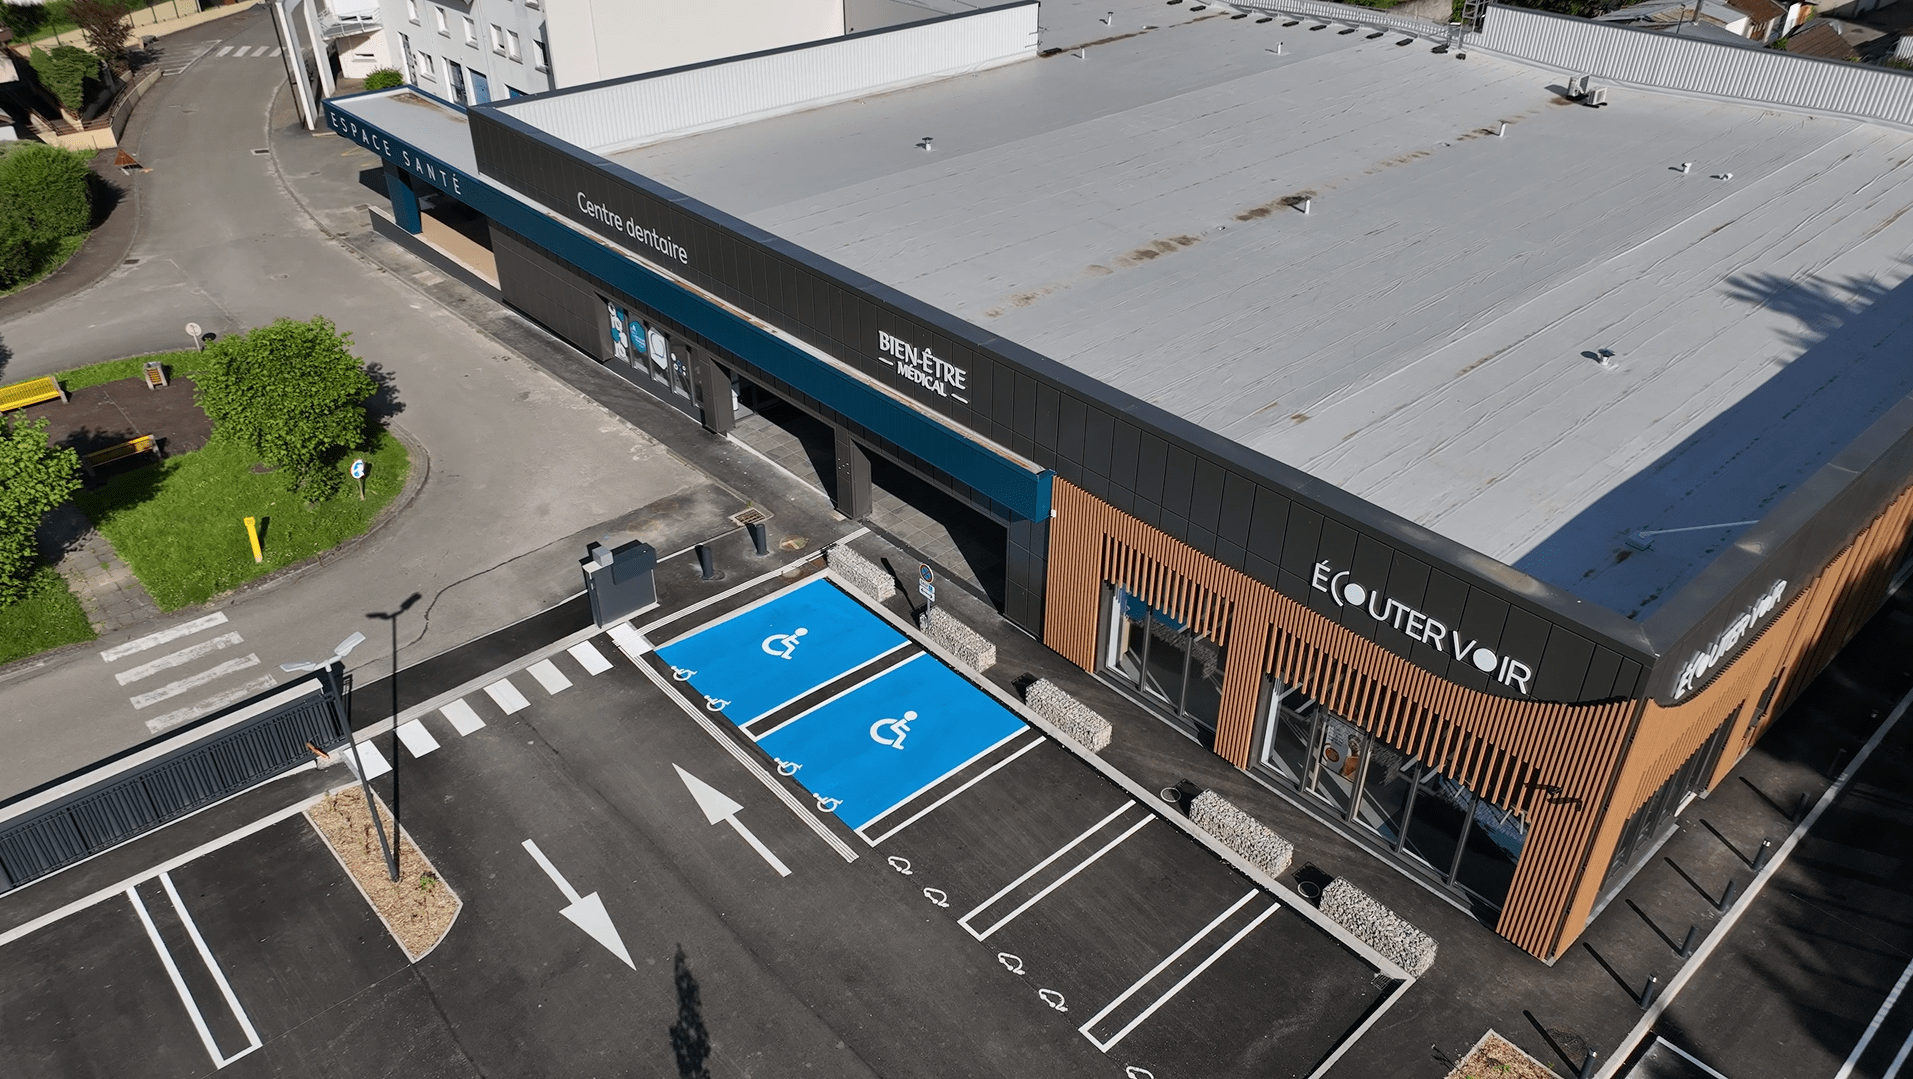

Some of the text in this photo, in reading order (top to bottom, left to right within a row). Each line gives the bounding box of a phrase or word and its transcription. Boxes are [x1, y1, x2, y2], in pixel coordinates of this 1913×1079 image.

[330, 111, 462, 195] ESPACE SANTÉ
[577, 191, 688, 265] Centre dentaire
[878, 330, 967, 390] BIEN-ÊTRE
[897, 361, 948, 397] MÉDICAL
[1311, 559, 1532, 694] ÉCOUTER VOIR
